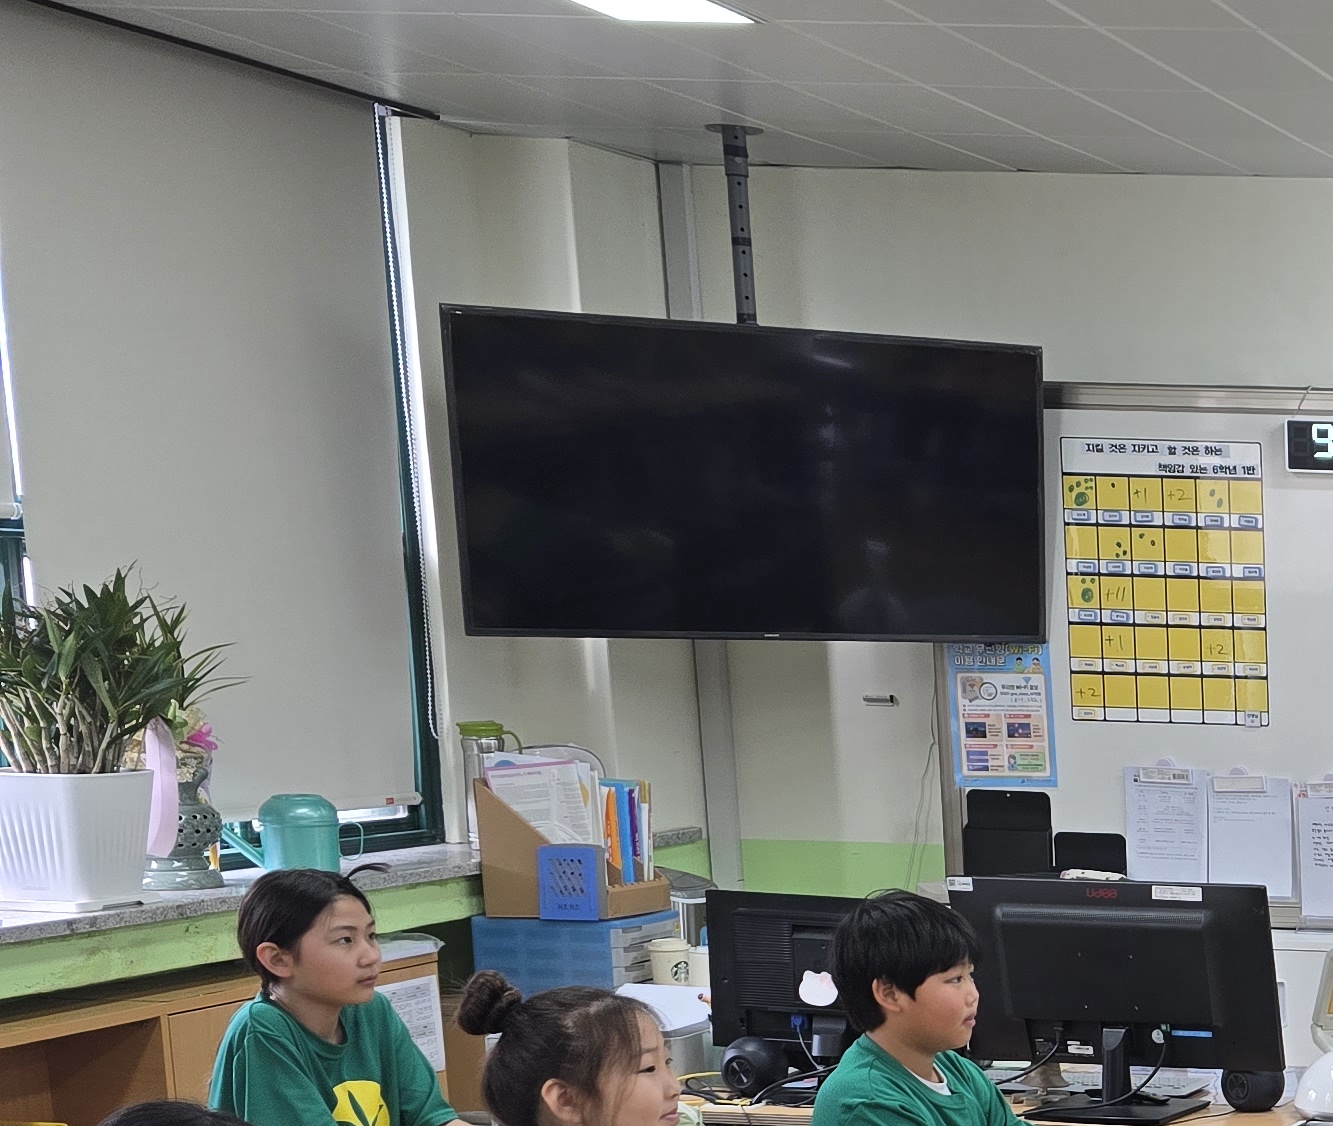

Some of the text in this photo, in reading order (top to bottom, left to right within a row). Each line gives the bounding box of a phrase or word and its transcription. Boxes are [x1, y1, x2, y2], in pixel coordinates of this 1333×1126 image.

[1085, 442, 1223, 457] 지킬 것은 지키고 할 것은 하는
[1158, 463, 1256, 476] 책임감 있는 6학년 1반
[954, 655, 1006, 667] 이용 안내문
